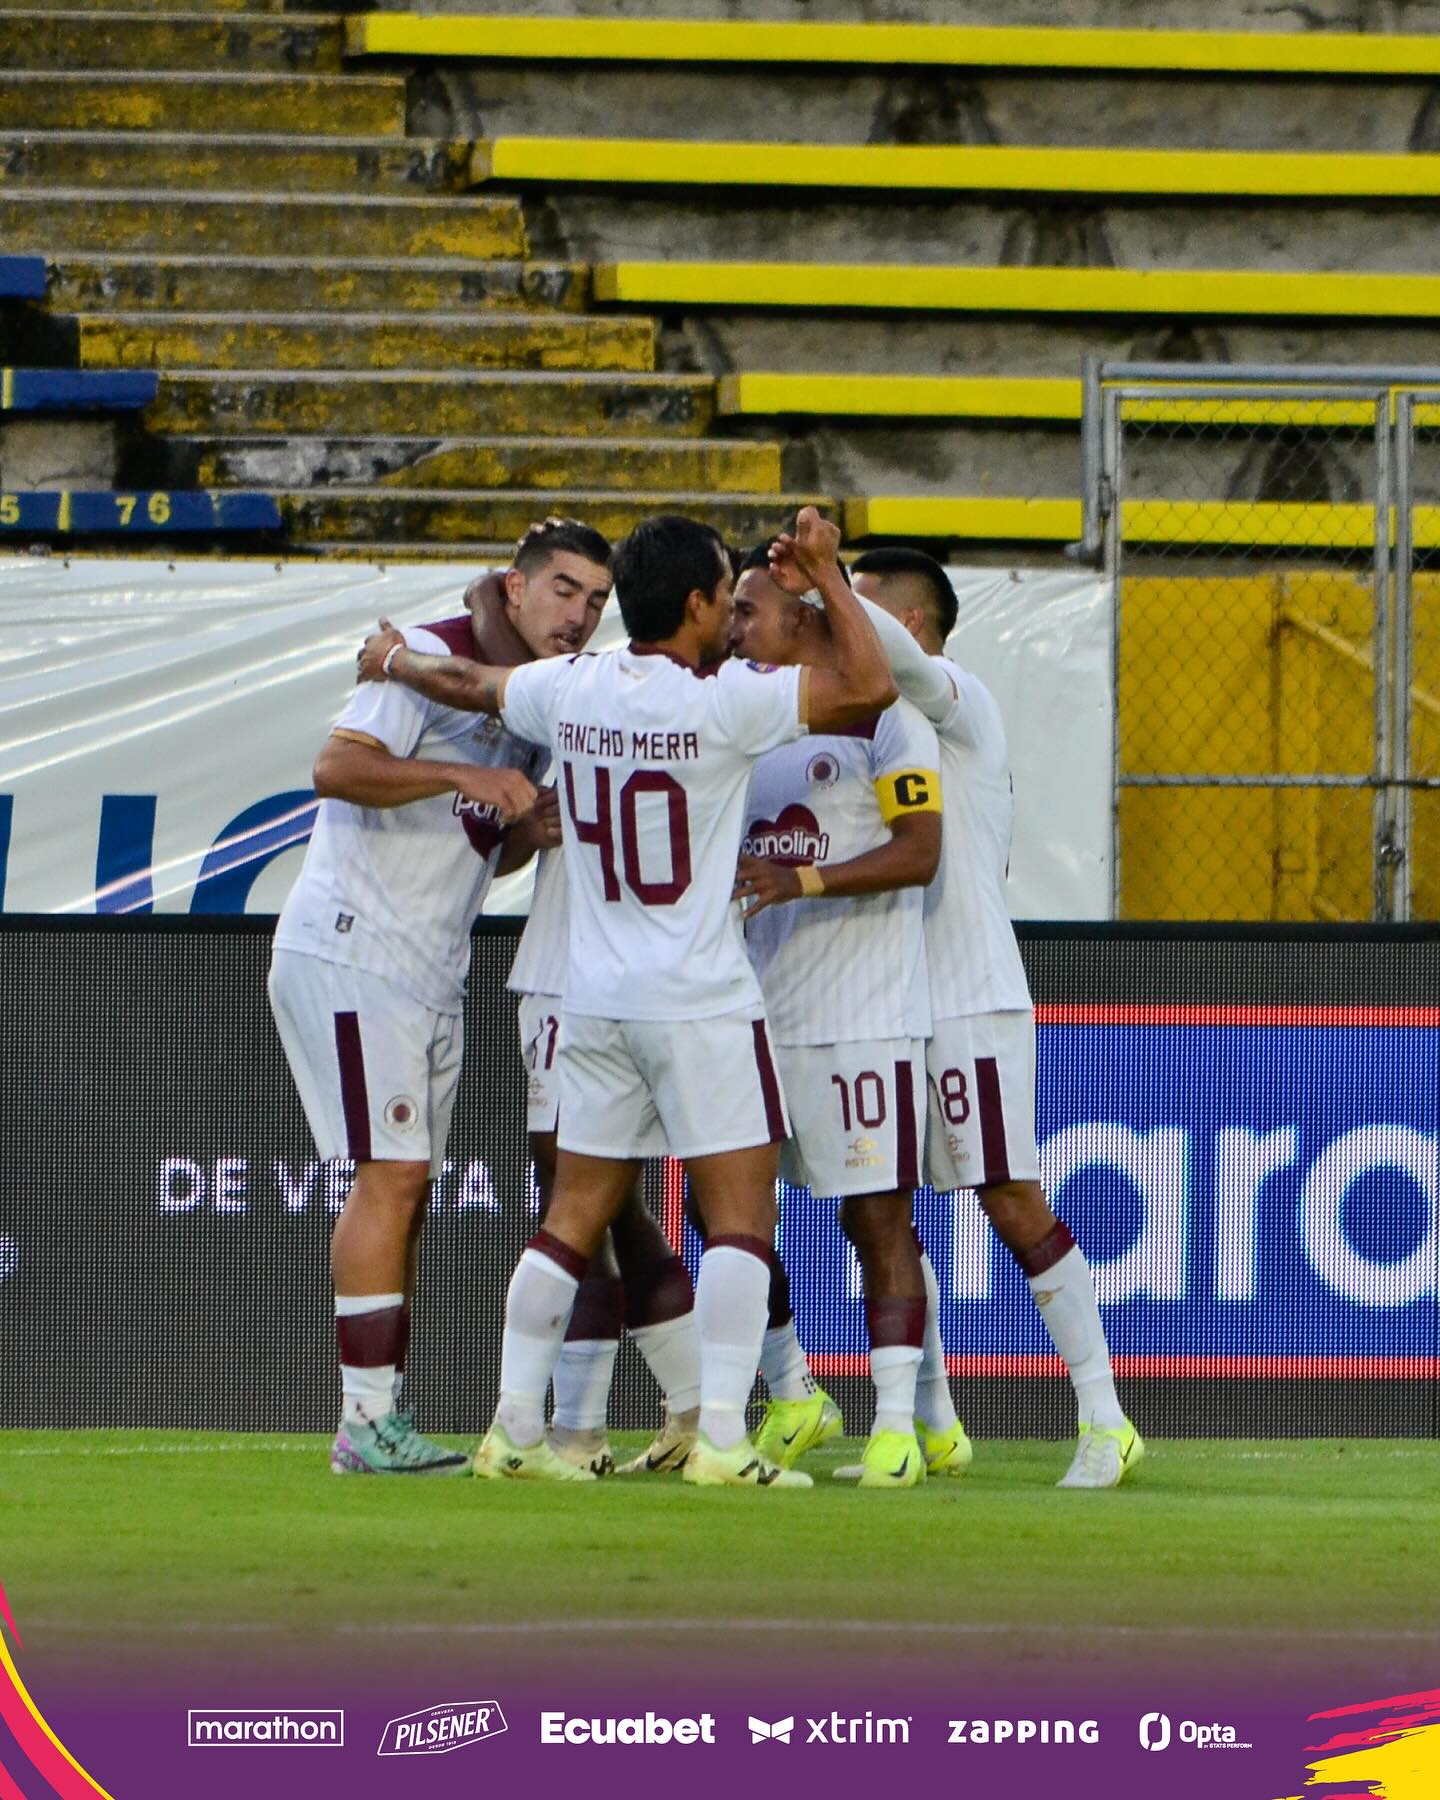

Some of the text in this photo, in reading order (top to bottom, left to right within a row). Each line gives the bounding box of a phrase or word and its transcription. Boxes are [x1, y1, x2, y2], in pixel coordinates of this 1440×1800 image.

[115, 492, 171, 526] 76
[558, 722, 699, 760] PANCHO MERA
[894, 773, 929, 806] C
[563, 761, 692, 906] 40
[832, 1070, 887, 1132] 10
[932, 1068, 970, 1127] 8
[159, 1158, 248, 1214] DE
[273, 1158, 499, 1214] VETA
